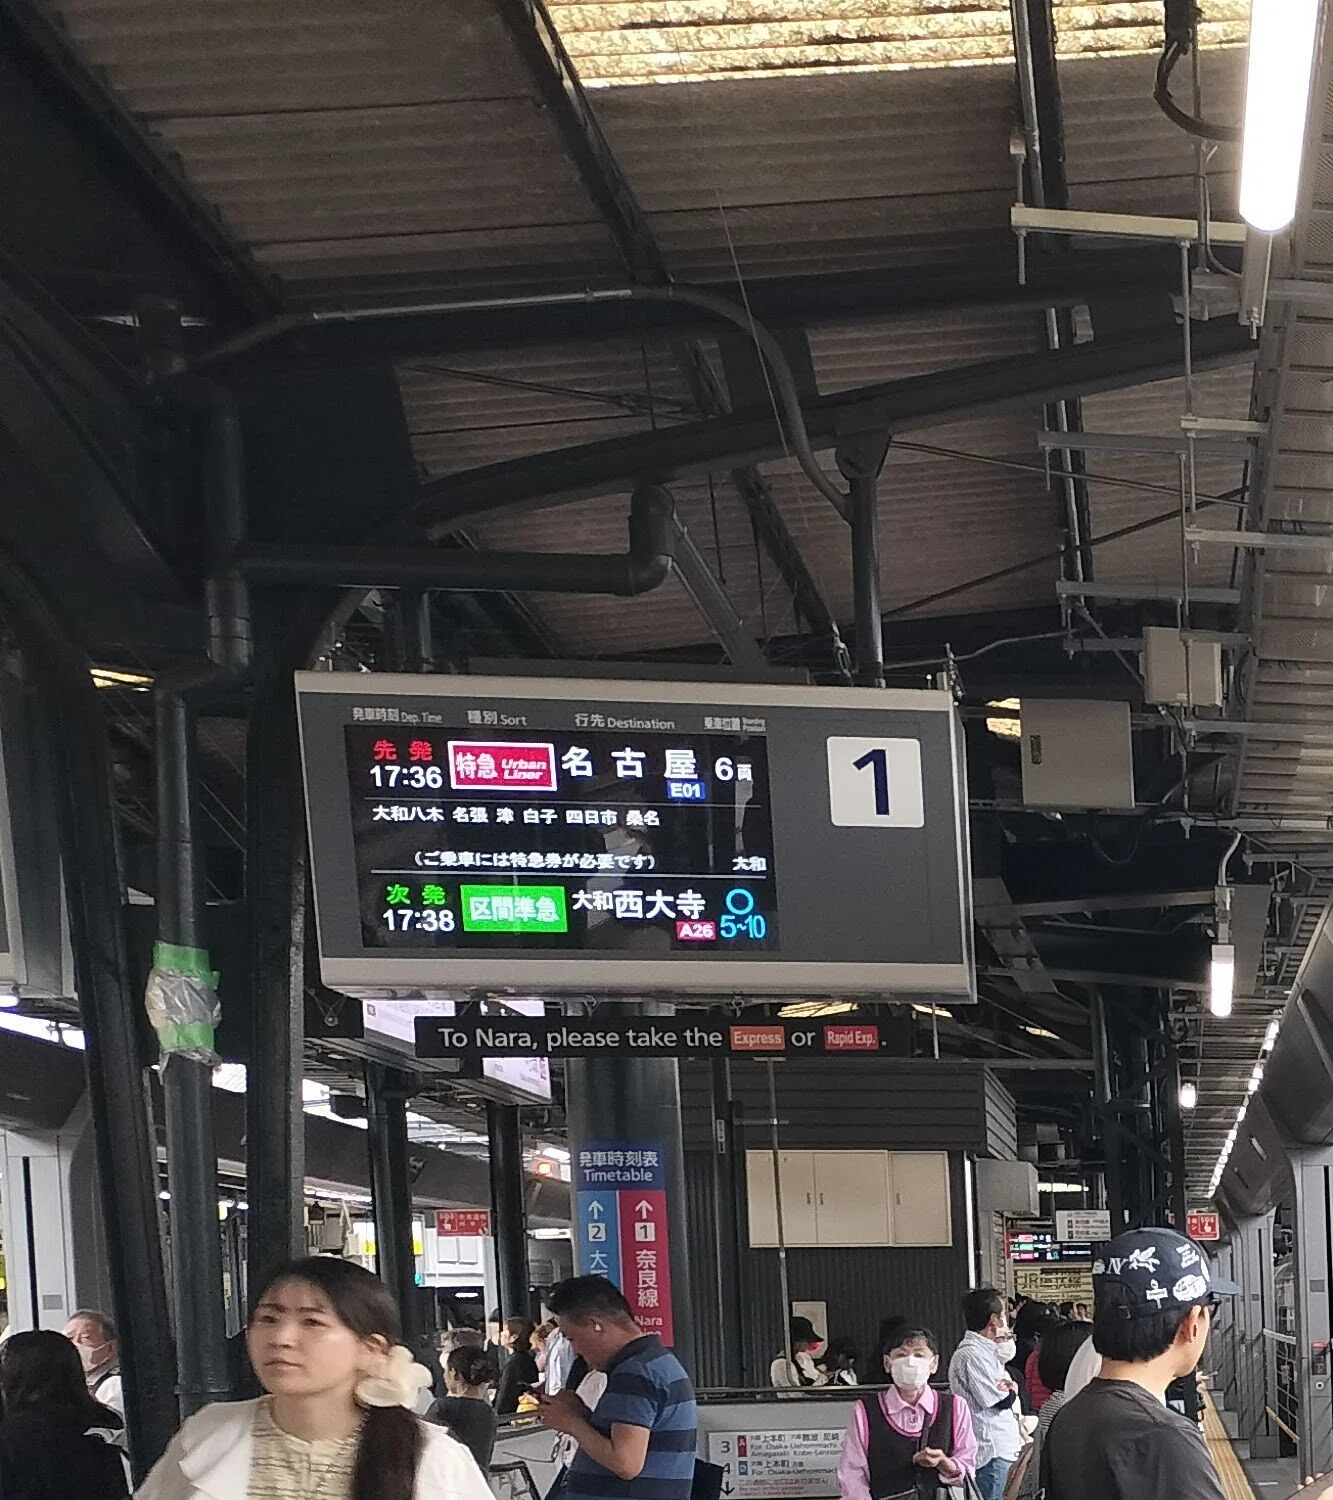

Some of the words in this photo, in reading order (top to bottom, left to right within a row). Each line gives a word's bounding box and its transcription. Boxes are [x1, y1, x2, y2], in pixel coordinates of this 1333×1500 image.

[500, 715, 527, 726] Sort
[574, 713, 605, 728] 行先
[607, 717, 675, 730] Destination
[372, 739, 433, 762] 先発
[455, 751, 498, 779] 特急
[501, 758, 548, 770] Urban
[561, 745, 698, 779] 名古屋
[369, 765, 443, 789] 17:36
[503, 768, 543, 780] Liner
[852, 749, 890, 815] 1
[670, 783, 702, 798] E01
[372, 805, 445, 822] 大和八木
[453, 807, 489, 823] 名張
[496, 808, 514, 825] 津
[523, 808, 558, 825] 白子
[565, 810, 618, 826] 四日市
[626, 810, 660, 827] 桑名
[732, 856, 767, 872] 大和
[386, 884, 446, 906] 次発
[469, 895, 560, 922] 区間準急
[572, 889, 707, 920] 大和西大寺
[382, 909, 456, 932] 17:38
[679, 923, 713, 938] A26
[438, 1028, 468, 1047] To
[476, 1028, 538, 1050] Nara,
[546, 1026, 620, 1052] please
[626, 1027, 677, 1047] take
[683, 1027, 723, 1046] the
[733, 1030, 782, 1047] Express
[791, 1032, 816, 1046] or
[827, 1030, 854, 1046] Rapid
[855, 1031, 877, 1045] Exp.
[579, 1150, 660, 1168] 発車時刻表
[584, 1168, 653, 1183] Timetable
[591, 1226, 603, 1239] 2
[640, 1225, 649, 1239] 1
[635, 1249, 660, 1308] 奈良線
[634, 1315, 663, 1327] Nara
[720, 1441, 731, 1453] 3
[723, 1462, 731, 1474] 4
